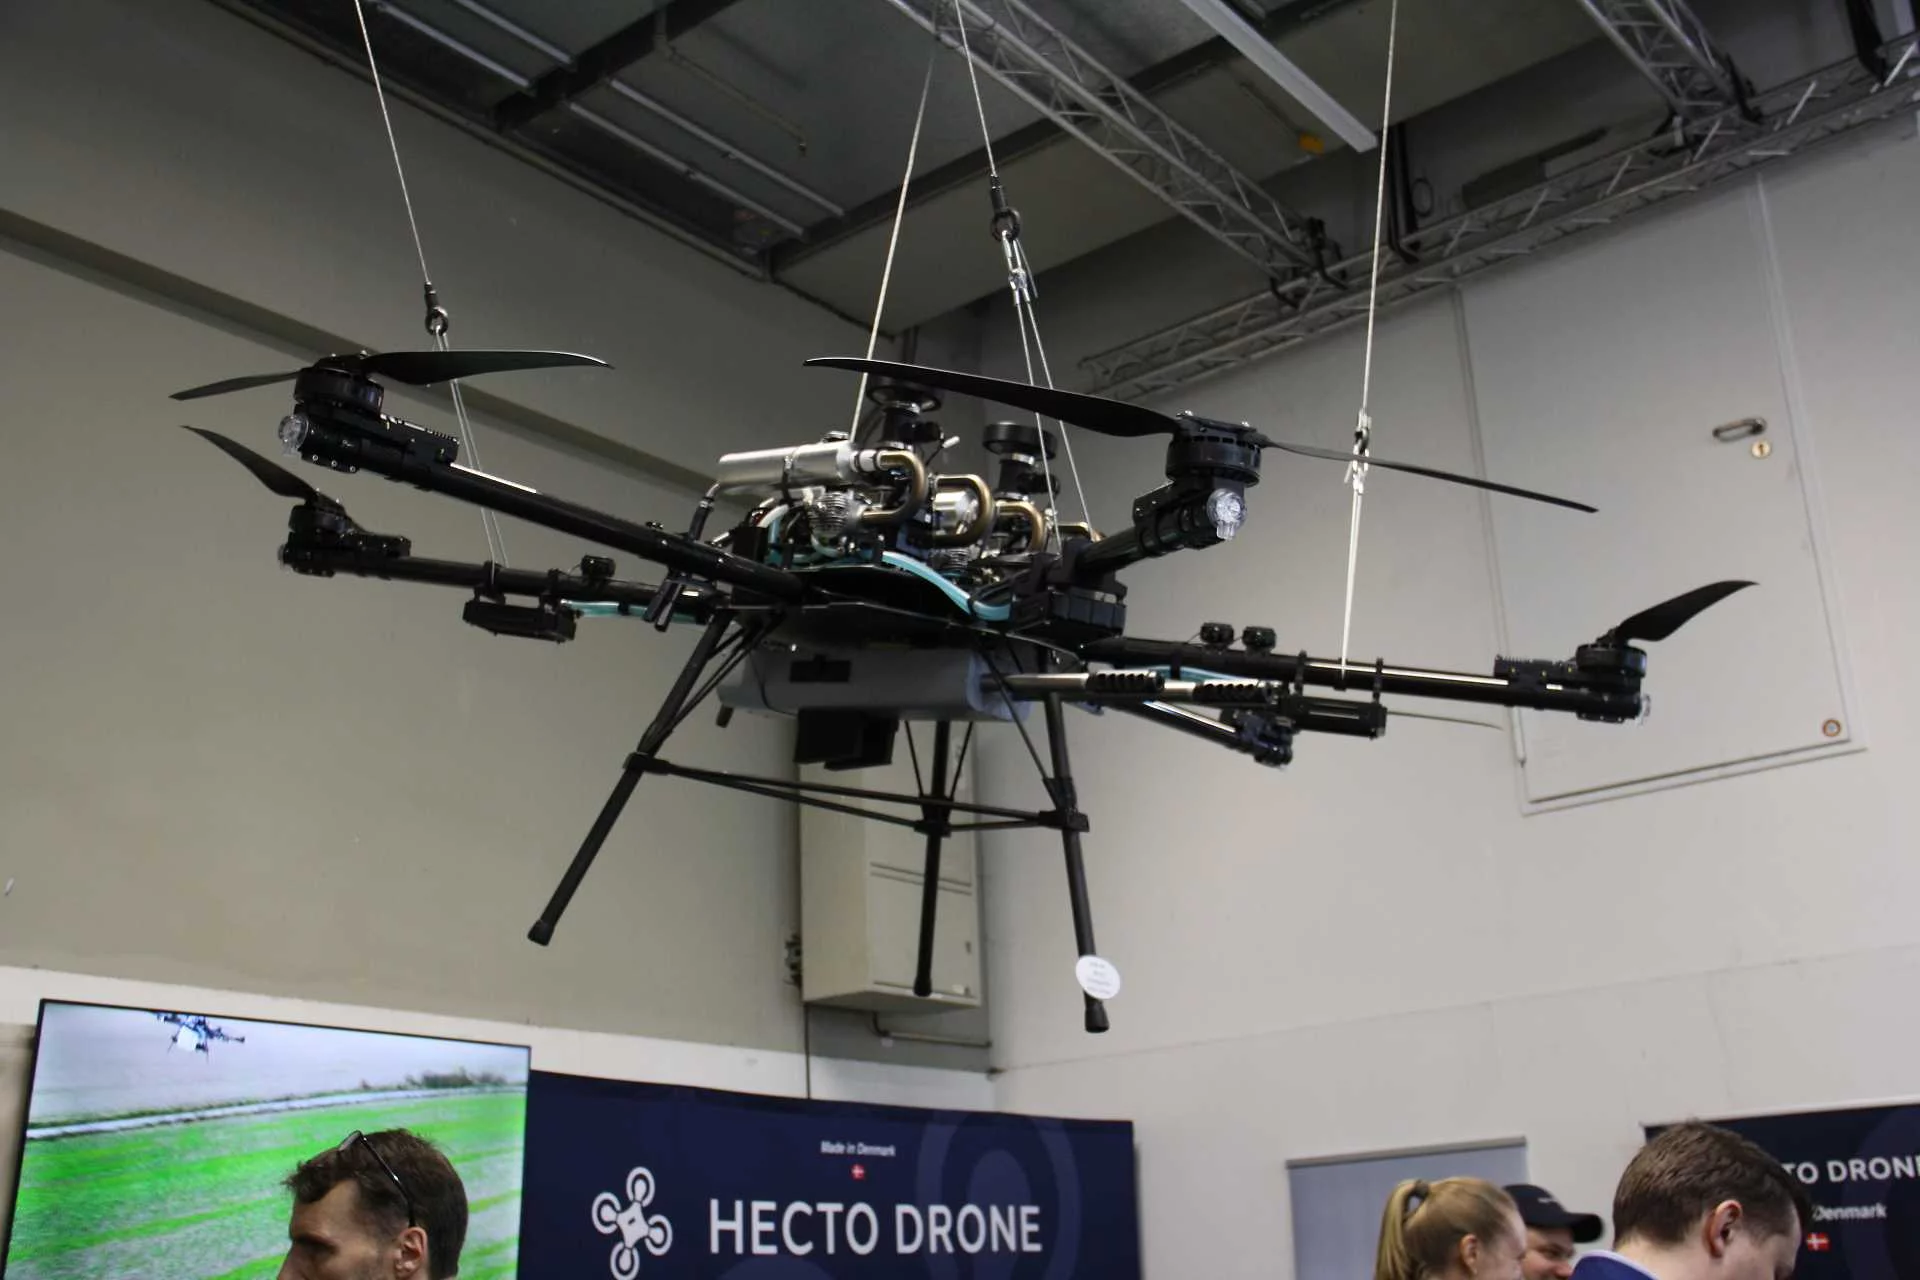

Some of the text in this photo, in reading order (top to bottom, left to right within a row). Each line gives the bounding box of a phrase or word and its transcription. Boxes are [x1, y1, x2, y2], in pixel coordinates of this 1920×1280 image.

[821, 1140, 896, 1157] Made in Denmark
[1812, 1202, 1888, 1221] Denmark
[710, 1198, 1043, 1256] HECTO DRONE
